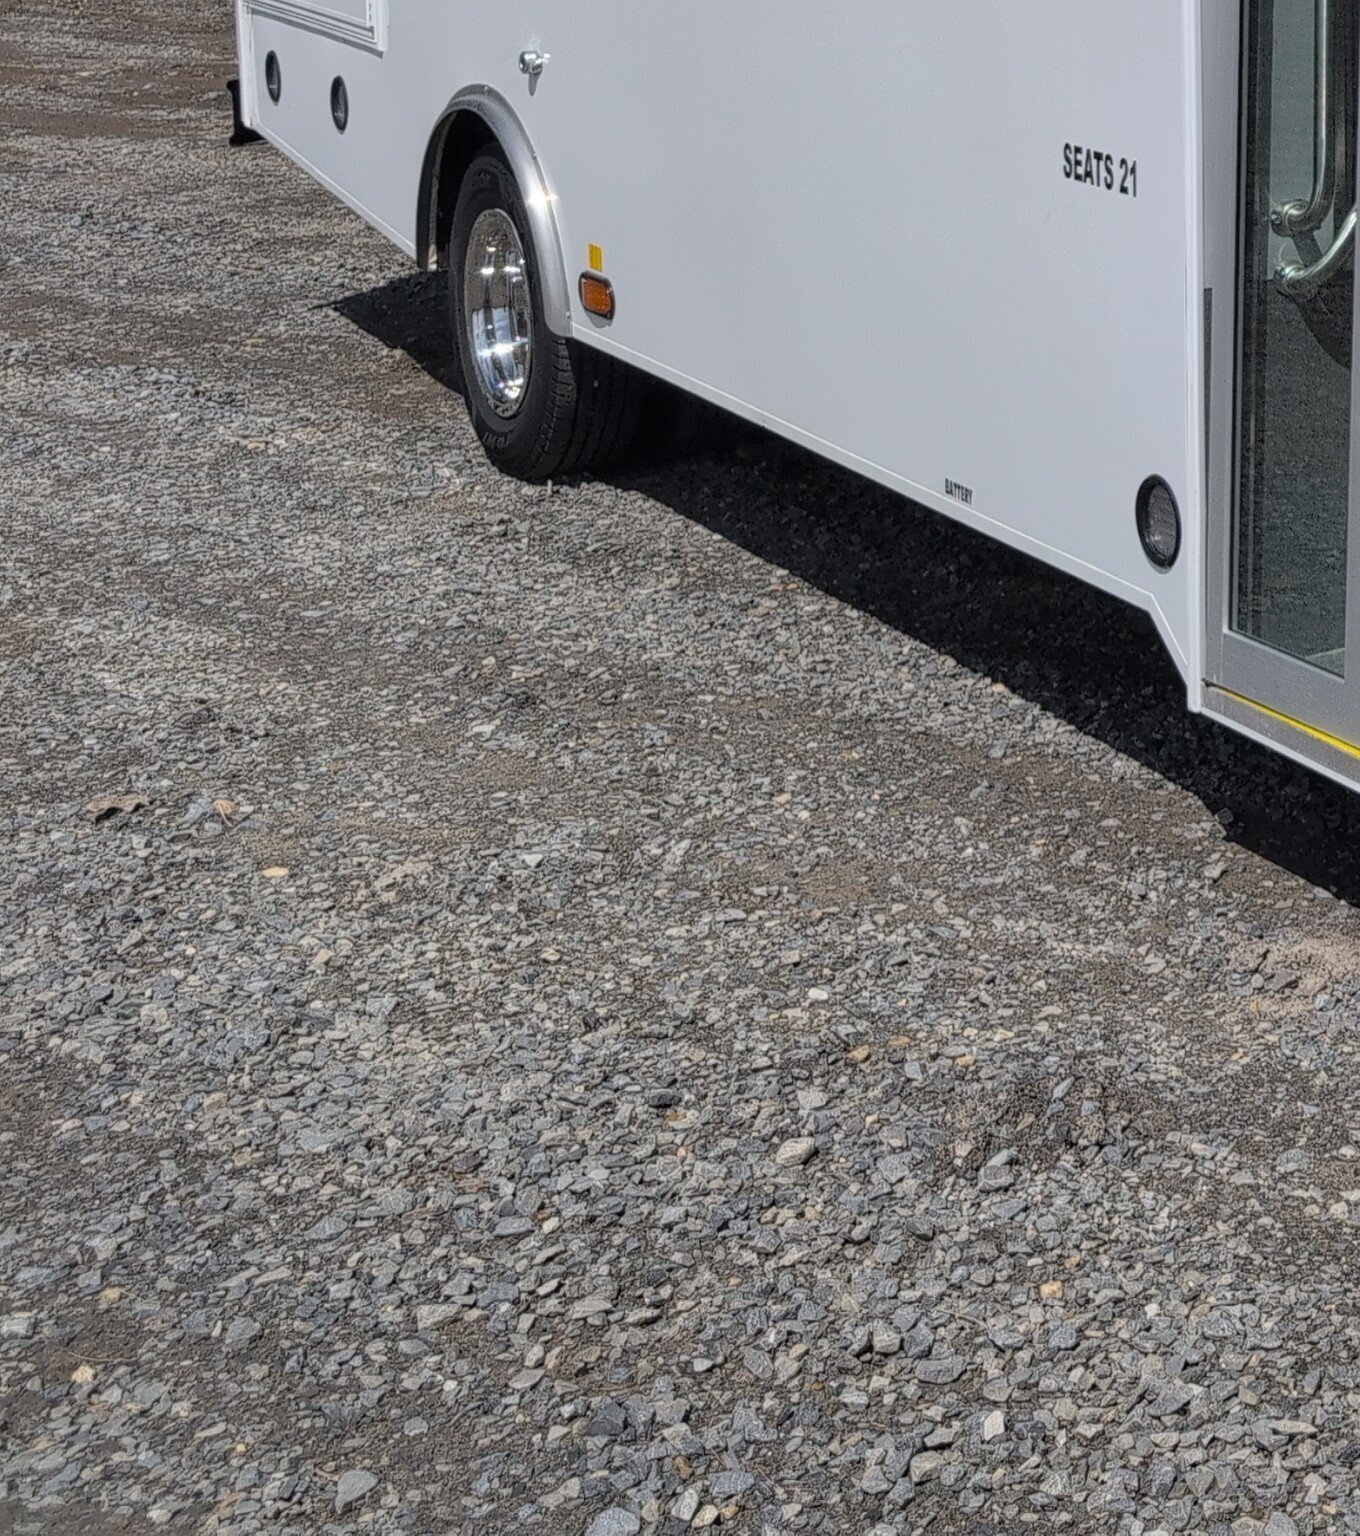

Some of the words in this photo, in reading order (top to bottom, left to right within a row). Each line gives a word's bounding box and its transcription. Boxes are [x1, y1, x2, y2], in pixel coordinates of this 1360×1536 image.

[1063, 142, 1114, 191] SEATS
[1119, 157, 1138, 197] 21
[944, 477, 973, 506] BATTERY
